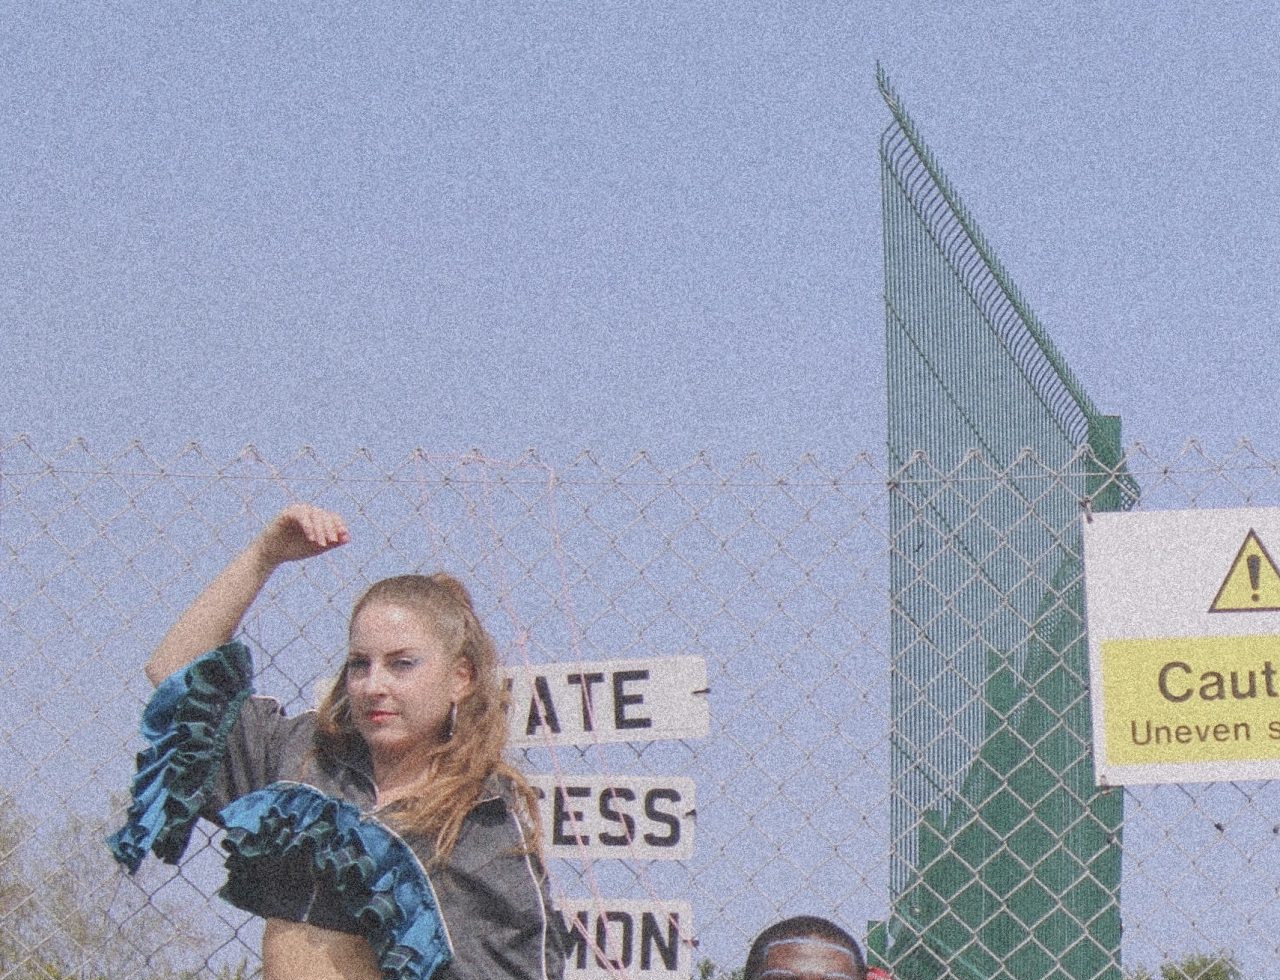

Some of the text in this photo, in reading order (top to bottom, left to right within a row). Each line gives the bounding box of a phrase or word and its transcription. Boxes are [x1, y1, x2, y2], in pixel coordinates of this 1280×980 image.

[503, 669, 652, 736] ATE
[1131, 720, 1251, 746] Uneven
[530, 786, 682, 847] ESS
